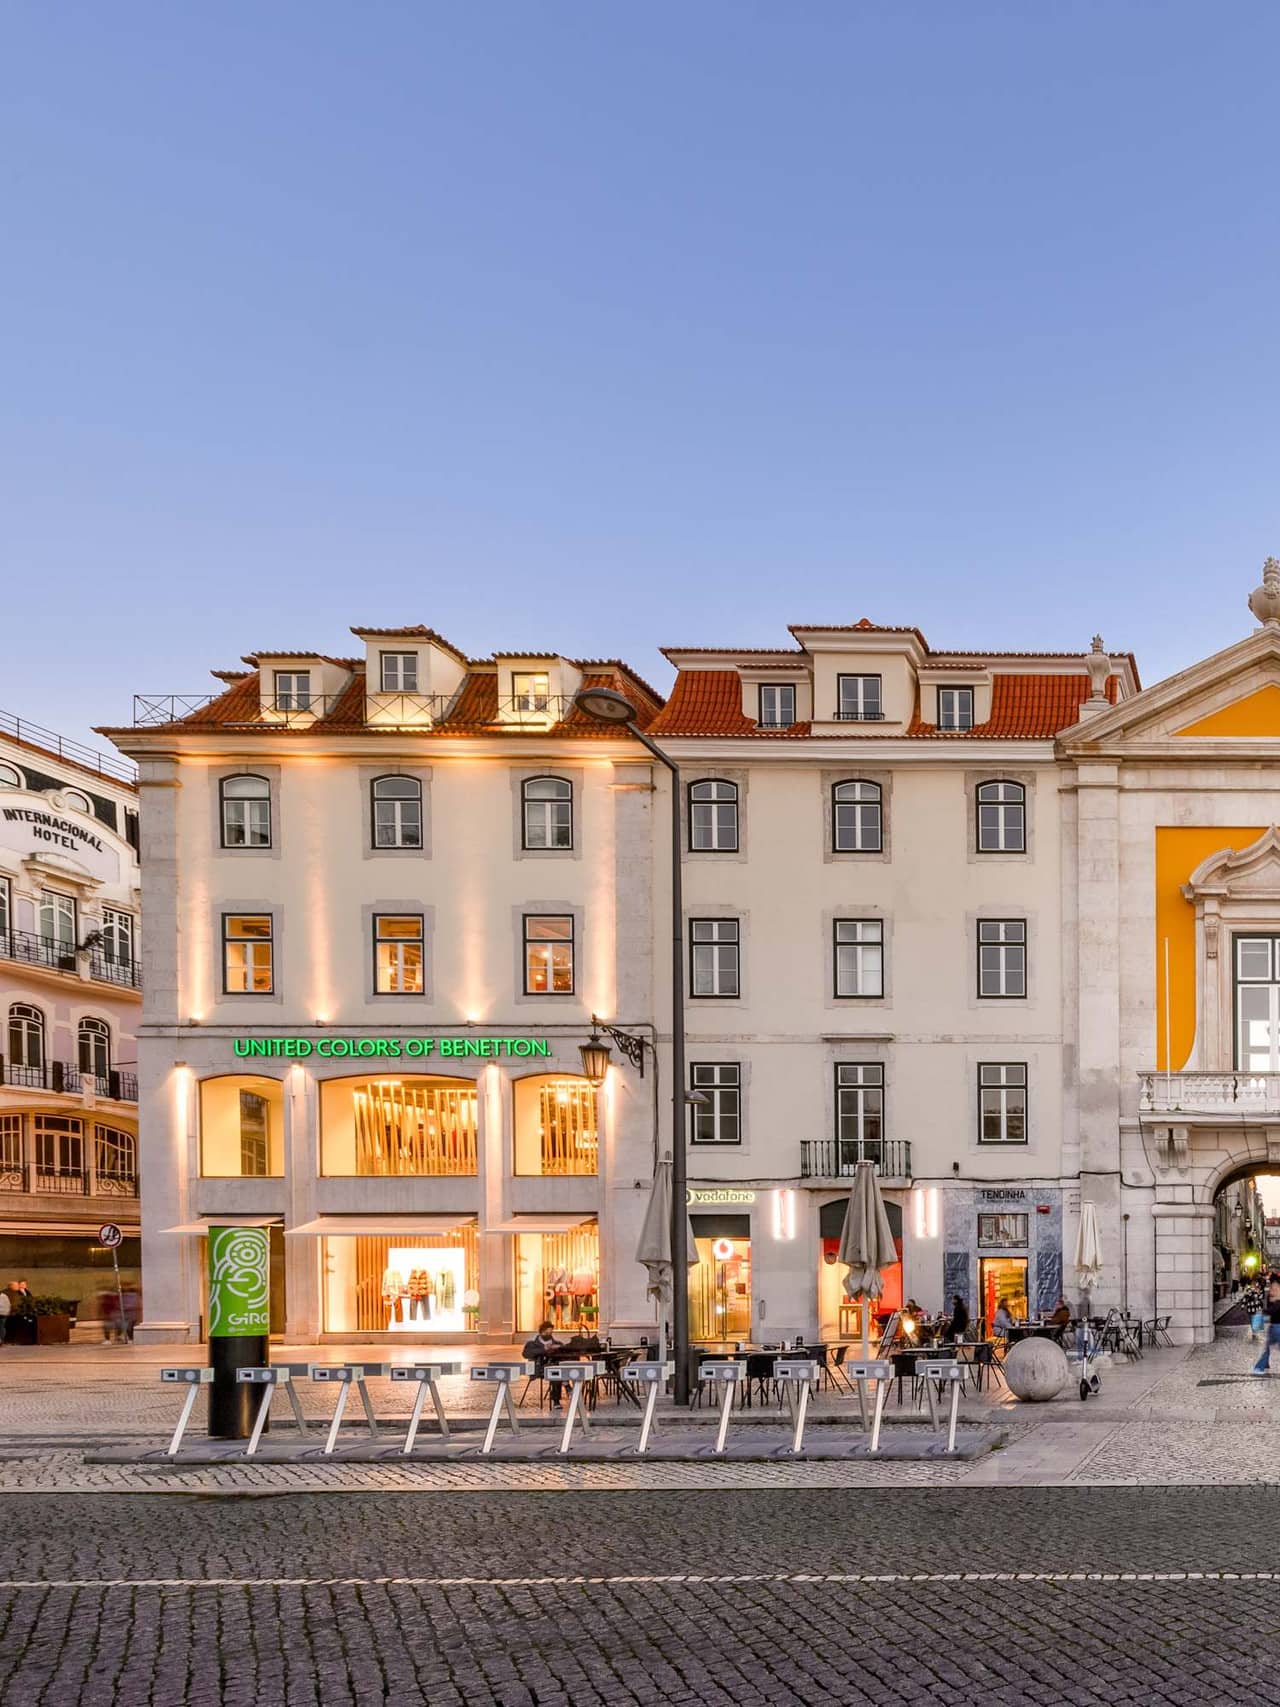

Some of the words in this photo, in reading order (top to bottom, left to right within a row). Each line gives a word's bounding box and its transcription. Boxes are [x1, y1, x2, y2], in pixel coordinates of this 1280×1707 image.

[3, 809, 103, 853] INTERNACIONAL
[33, 826, 79, 851] HOTEL
[234, 1039, 312, 1057] UNITED
[316, 1039, 400, 1057] COLORS
[405, 1039, 434, 1057] OF
[442, 1039, 551, 1057] BENETTON.
[695, 1190, 753, 1202] vodafone
[981, 1190, 1025, 1199] TENDINHA
